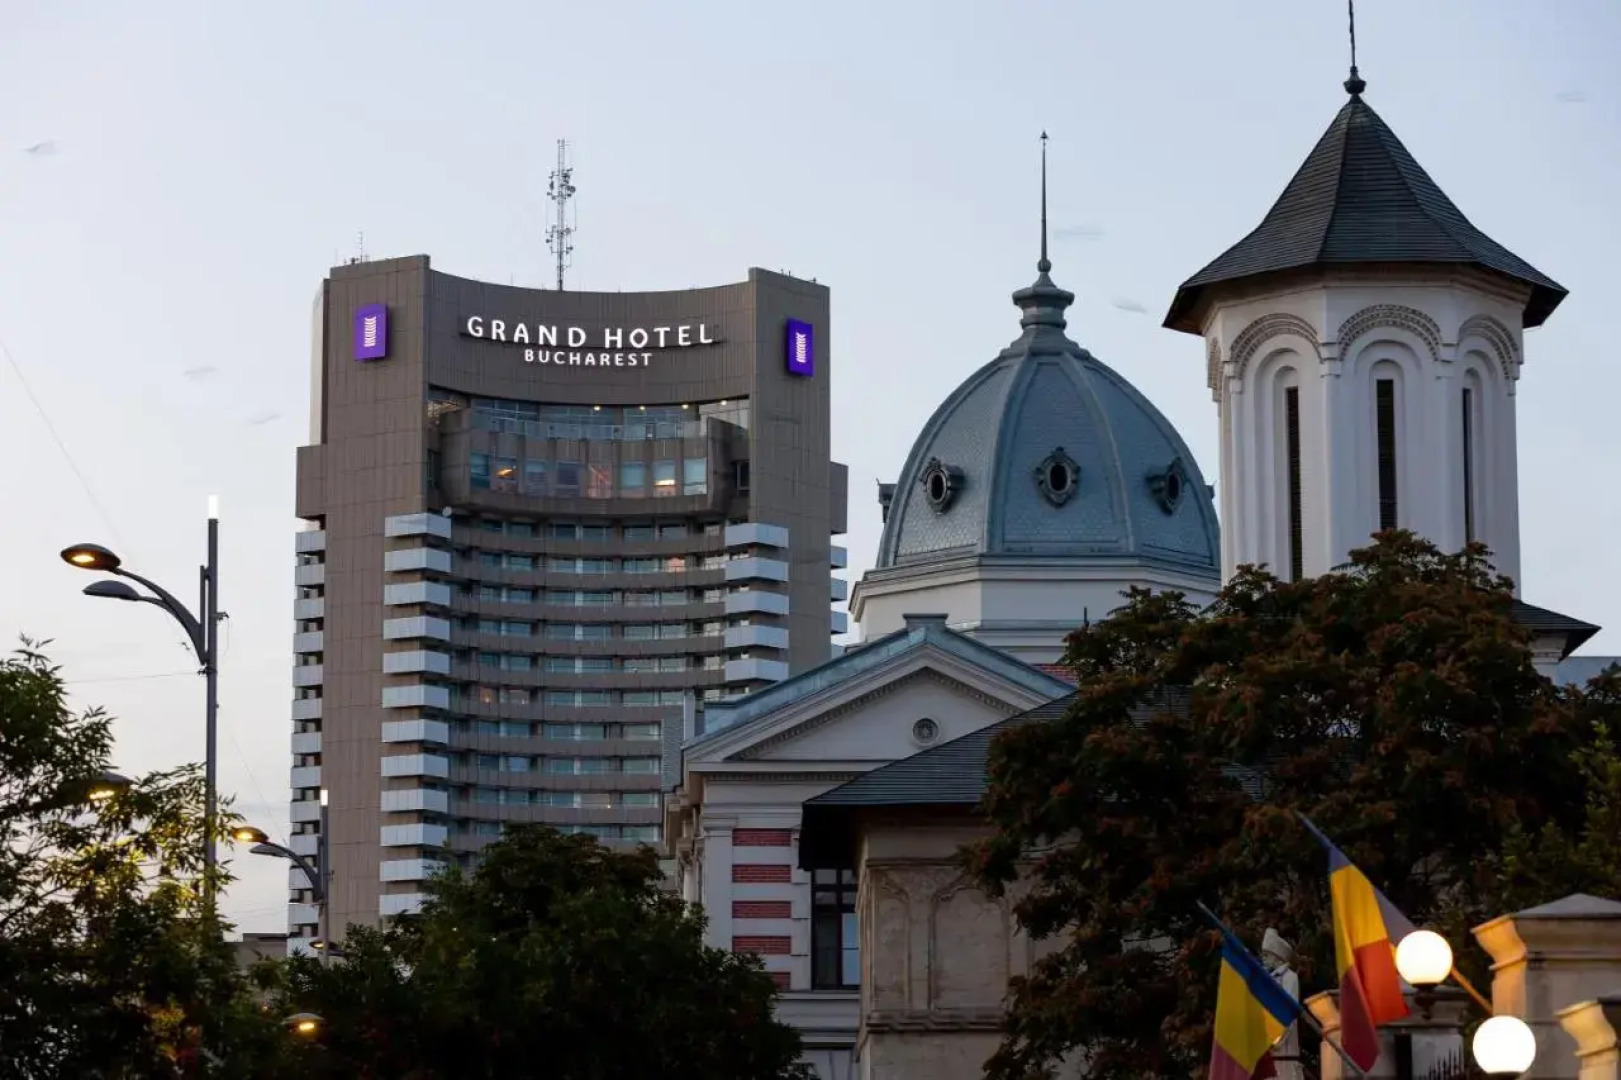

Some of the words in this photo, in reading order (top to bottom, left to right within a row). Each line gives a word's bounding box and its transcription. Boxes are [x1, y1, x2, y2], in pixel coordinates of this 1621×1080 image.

[466, 316, 588, 348] GRAND
[603, 324, 714, 349] HOTEL
[524, 349, 653, 366] BUCHAREST
